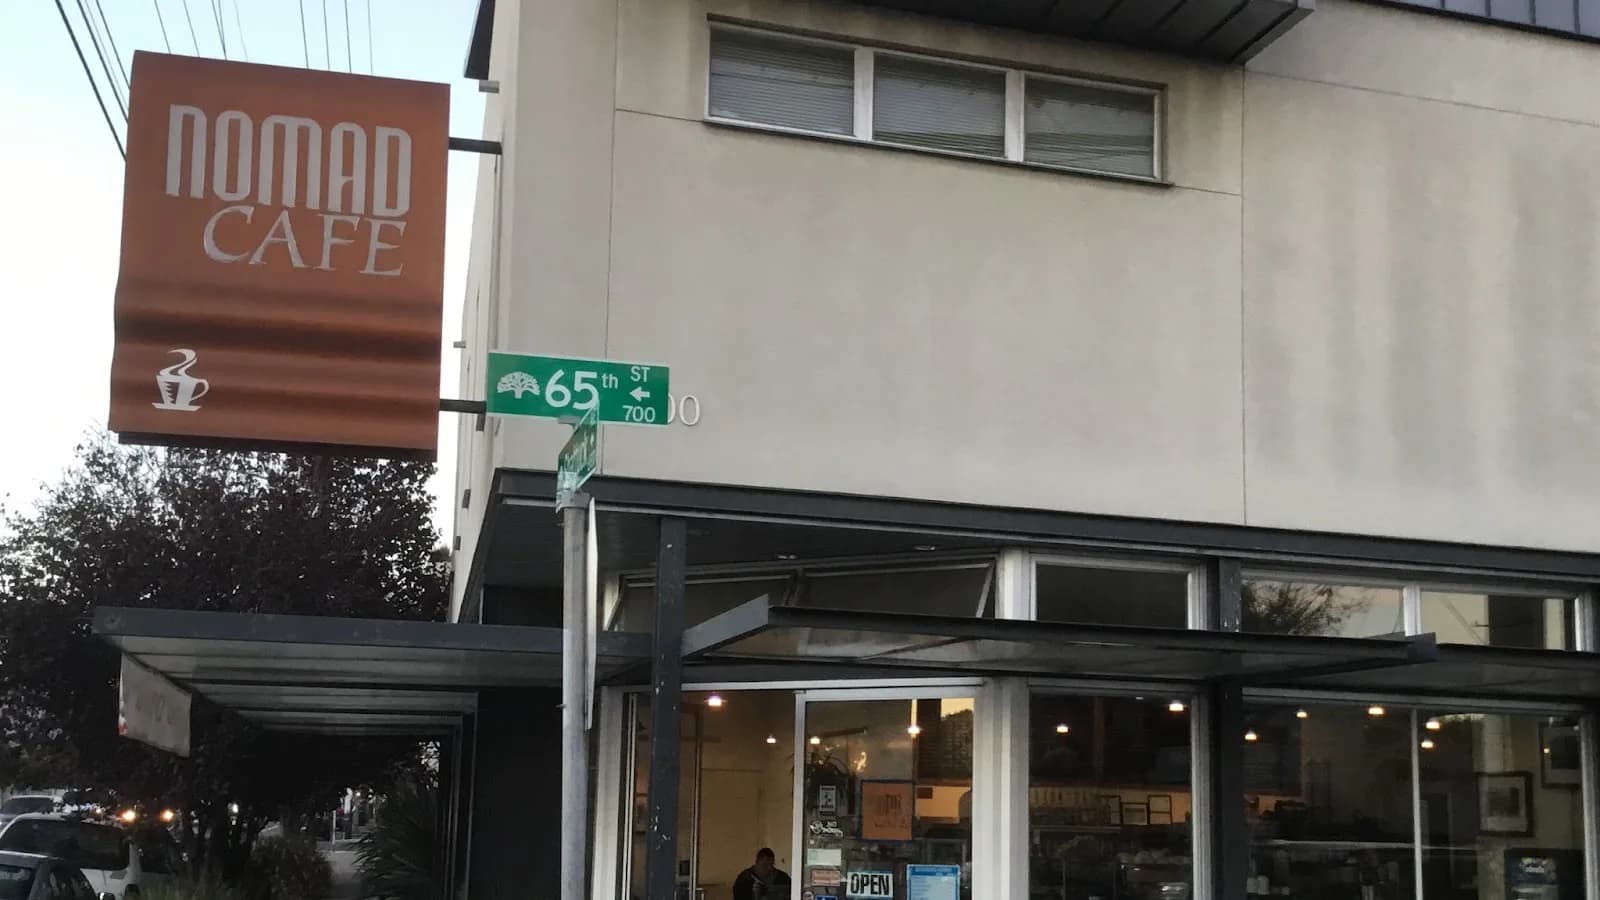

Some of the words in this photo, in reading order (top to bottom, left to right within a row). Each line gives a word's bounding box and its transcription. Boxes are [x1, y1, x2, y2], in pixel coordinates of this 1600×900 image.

[165, 103, 412, 218] NOMAD
[203, 205, 407, 277] CAFE
[545, 368, 619, 411] 65th
[630, 365, 651, 383] ST
[622, 405, 656, 423] 700
[850, 873, 890, 896] OPEN
